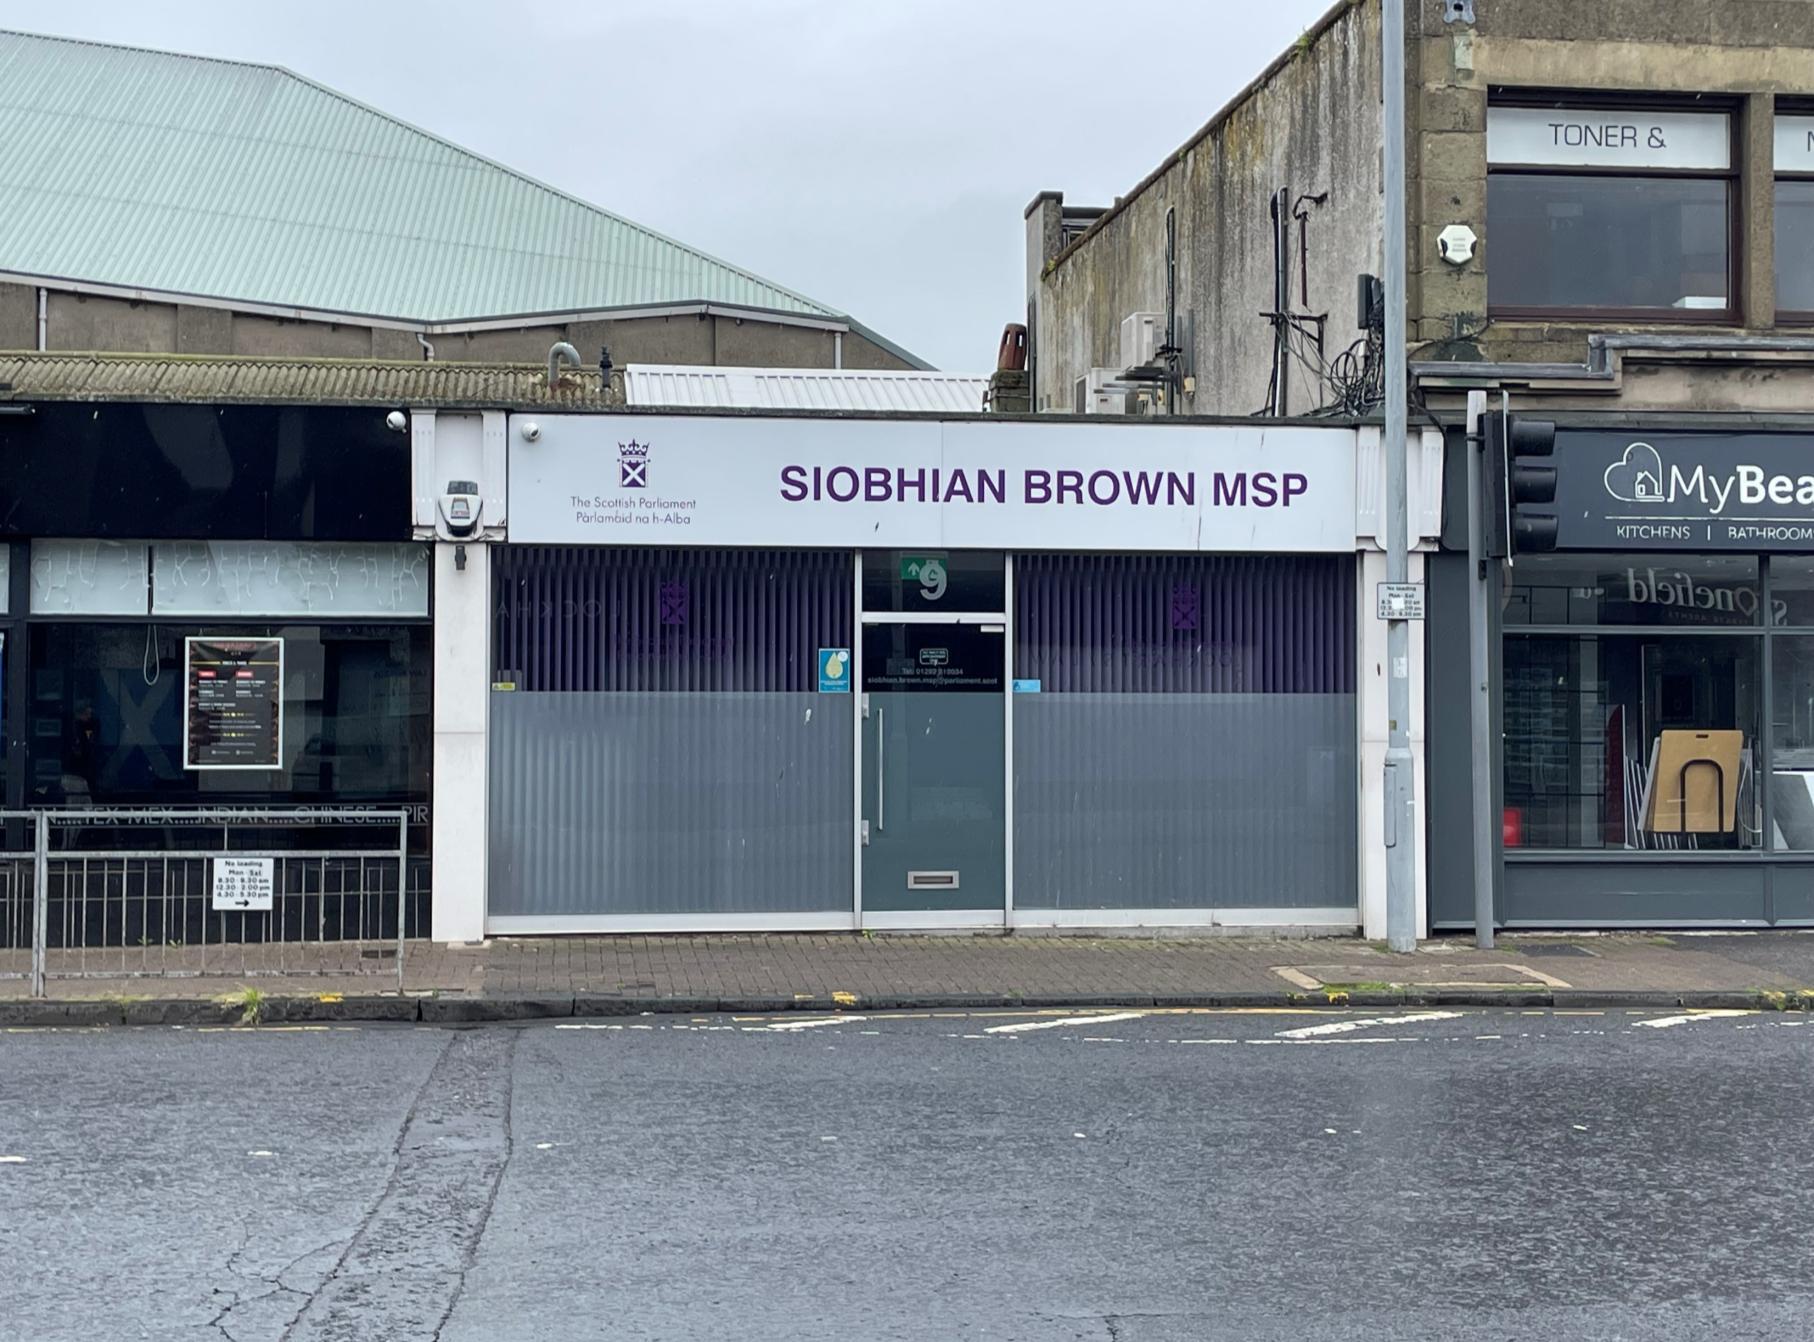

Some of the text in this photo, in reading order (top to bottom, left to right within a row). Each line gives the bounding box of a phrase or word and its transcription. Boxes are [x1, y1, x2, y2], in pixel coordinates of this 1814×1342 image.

[1548, 123, 1667, 149] TONER &
[780, 465, 1308, 508] SIOBHIAN BROWN MSP
[570, 495, 697, 510] The Scottish Parliament
[635, 514, 650, 523] na
[653, 511, 691, 525] h-Alba
[1616, 524, 1814, 542] KITCHENS BATHROOM
[919, 562, 947, 600] 9
[237, 860, 263, 868] loading
